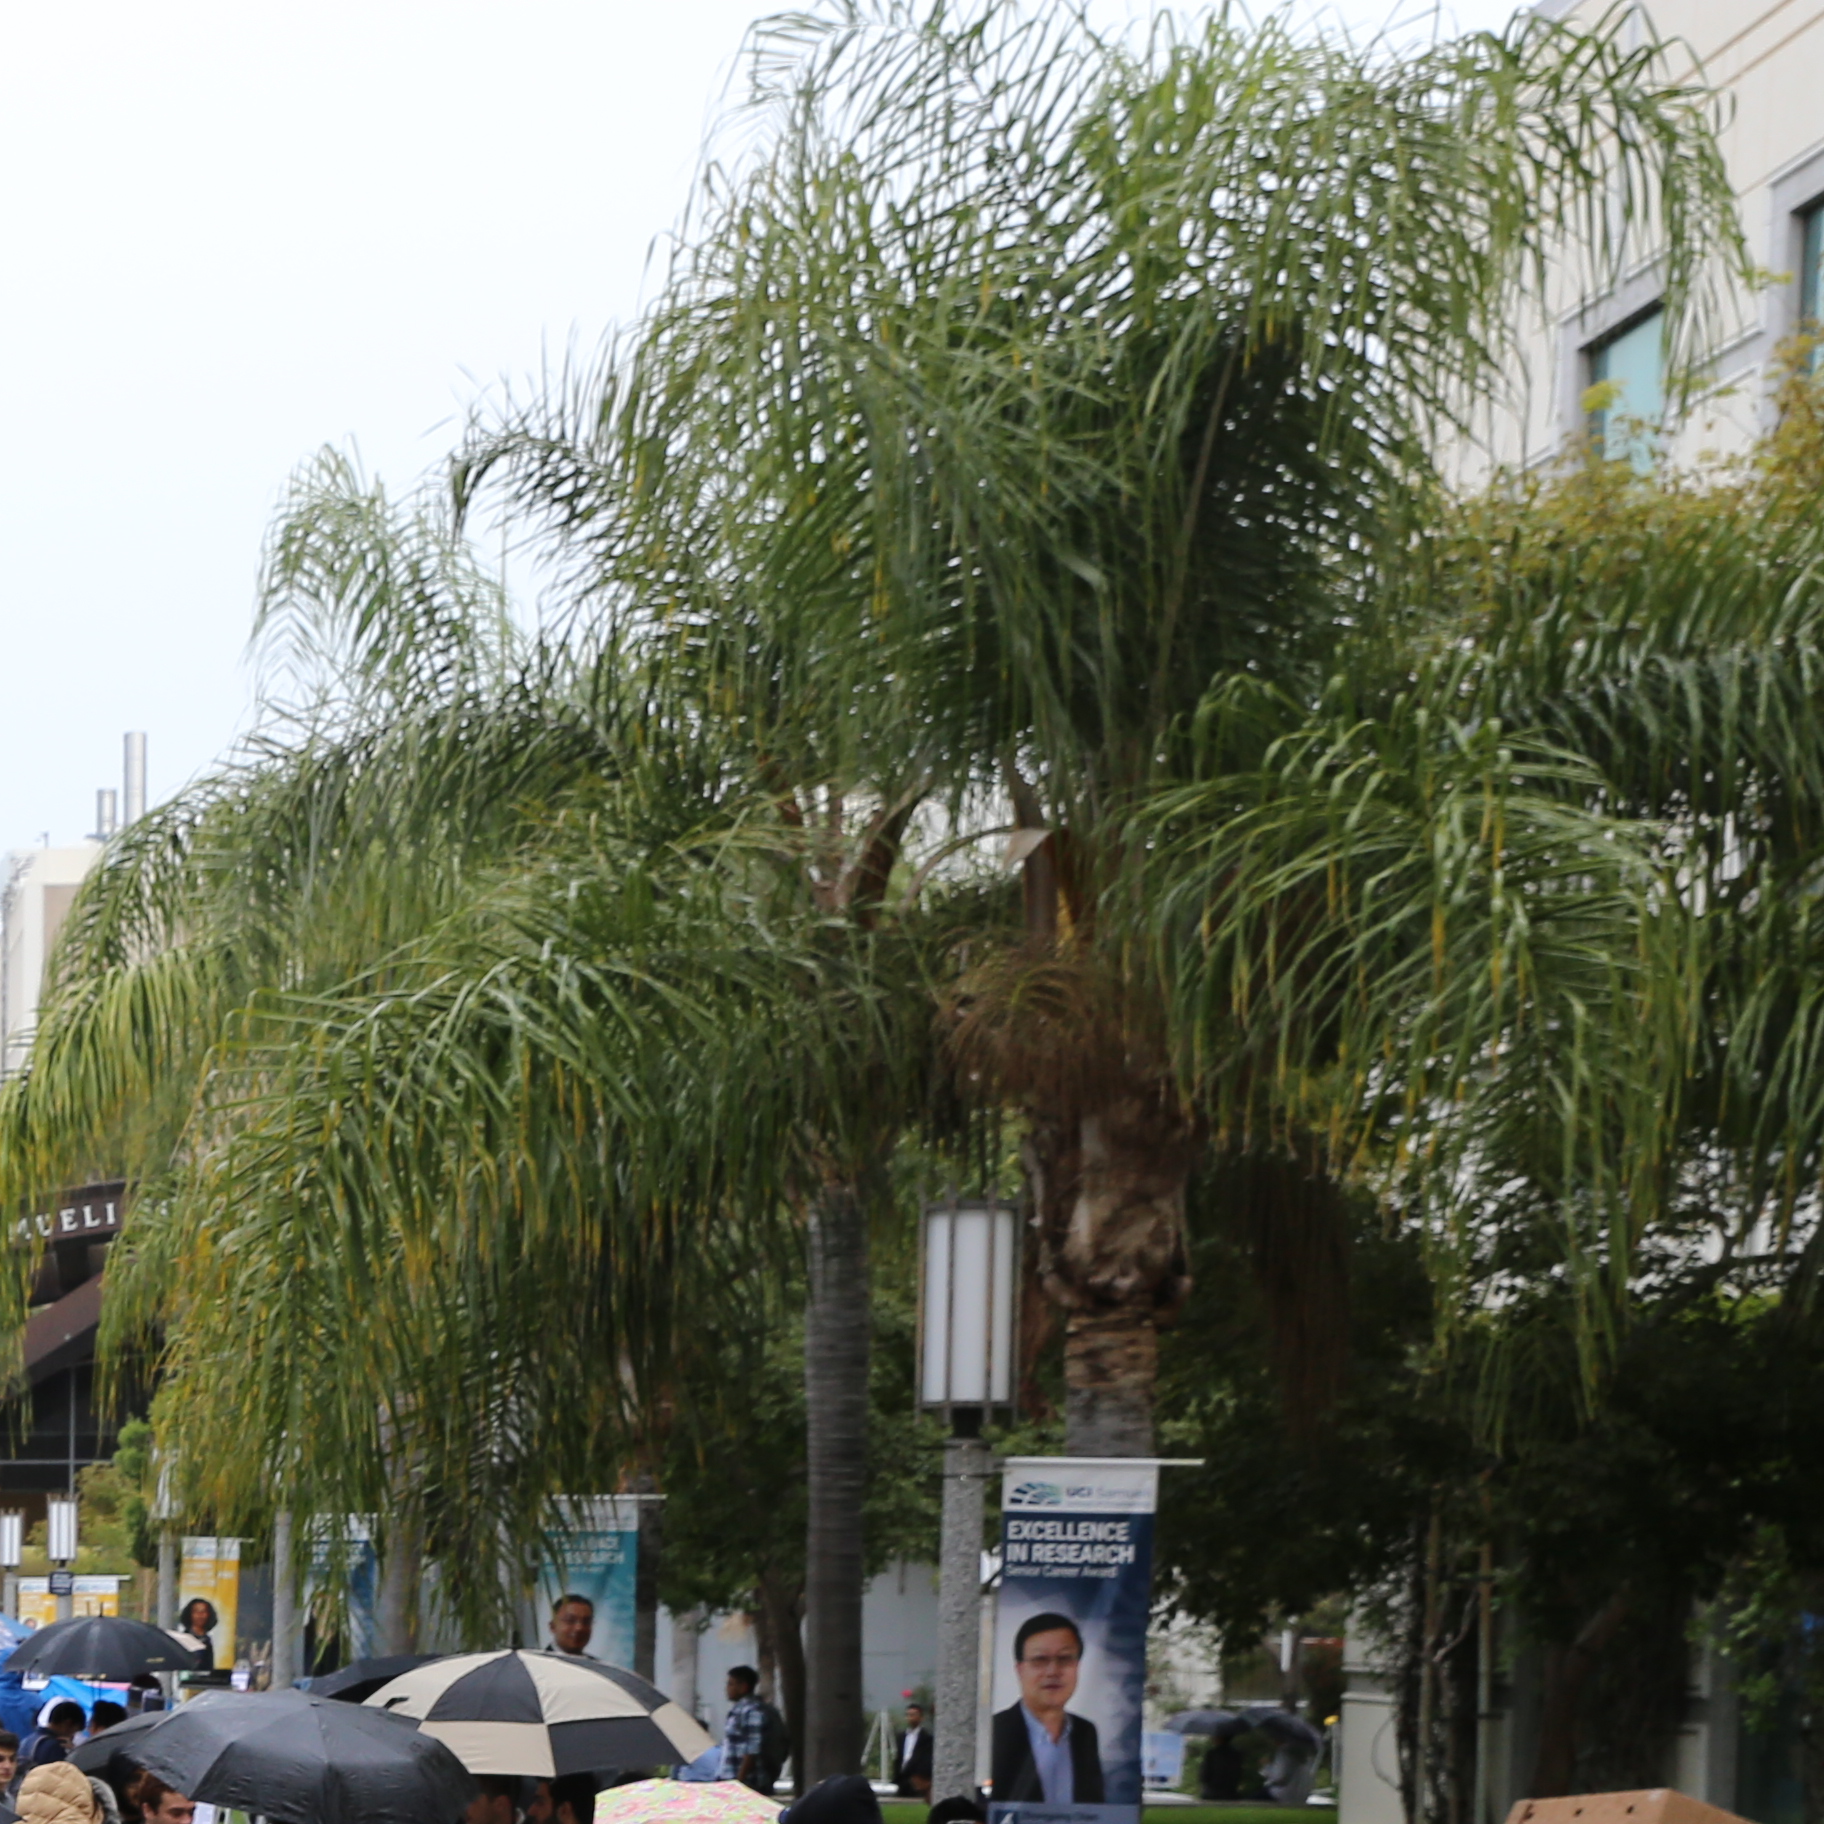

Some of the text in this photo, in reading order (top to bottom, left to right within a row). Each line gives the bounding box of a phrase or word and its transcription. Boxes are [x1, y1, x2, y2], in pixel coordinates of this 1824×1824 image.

[1006, 1519, 1130, 1541] EXCELLENCE
[1006, 1543, 1136, 1564] IN RESEARCH
[1005, 1565, 1118, 1578] Senior Career Award
